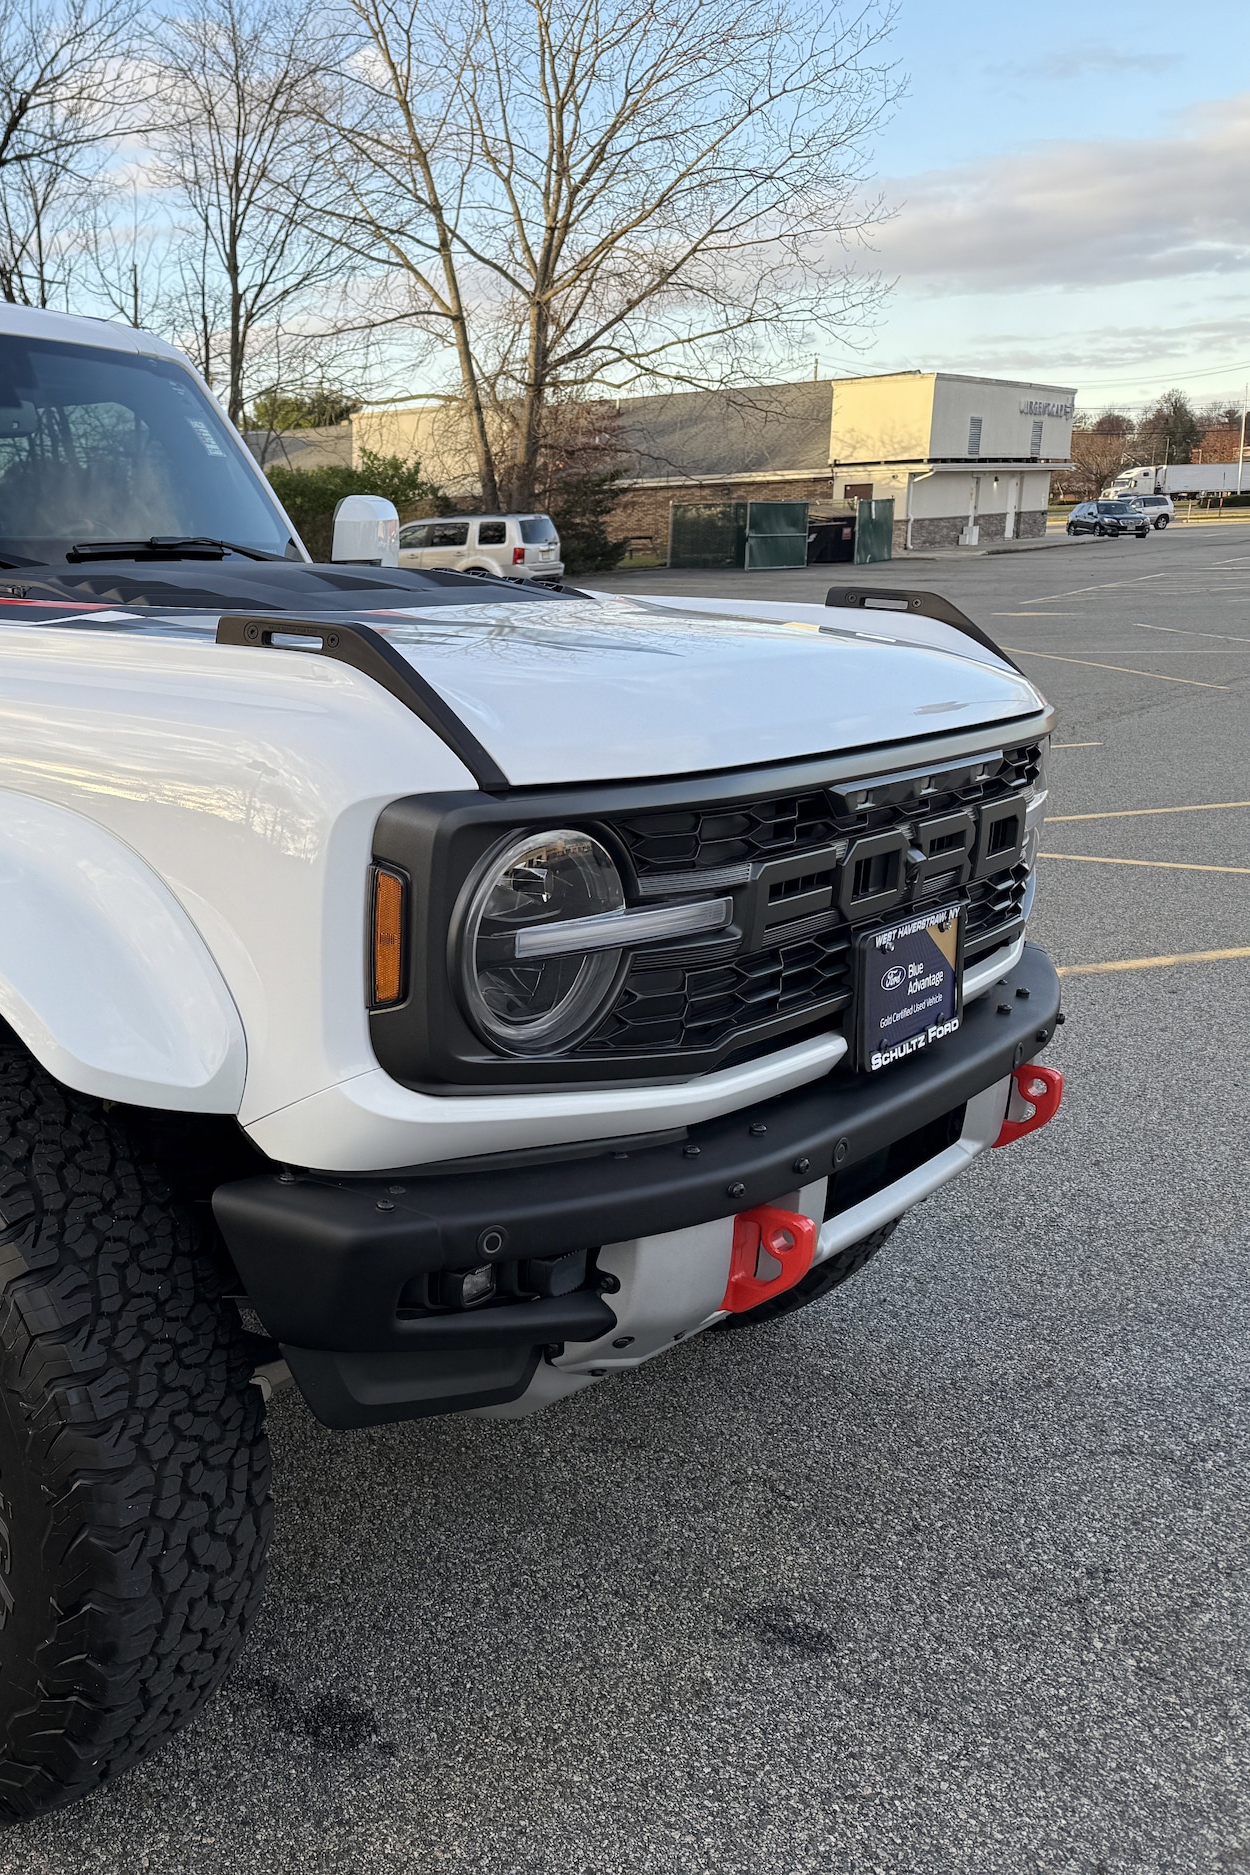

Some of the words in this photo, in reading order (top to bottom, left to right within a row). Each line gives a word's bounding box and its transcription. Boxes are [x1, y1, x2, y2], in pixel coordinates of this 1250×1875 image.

[751, 793, 1027, 949] FORD
[875, 932, 896, 948] WEST
[949, 906, 961, 919] NY
[885, 969, 902, 988] Ford
[907, 962, 924, 978] Blue
[907, 971, 944, 995] Advantage
[879, 1015, 892, 1029] Gold
[892, 1005, 914, 1024] Certified
[913, 1000, 926, 1016] Used
[926, 993, 943, 1008] Vehicle
[871, 1035, 926, 1071] SCHULTZ
[928, 1018, 960, 1043] FORD
